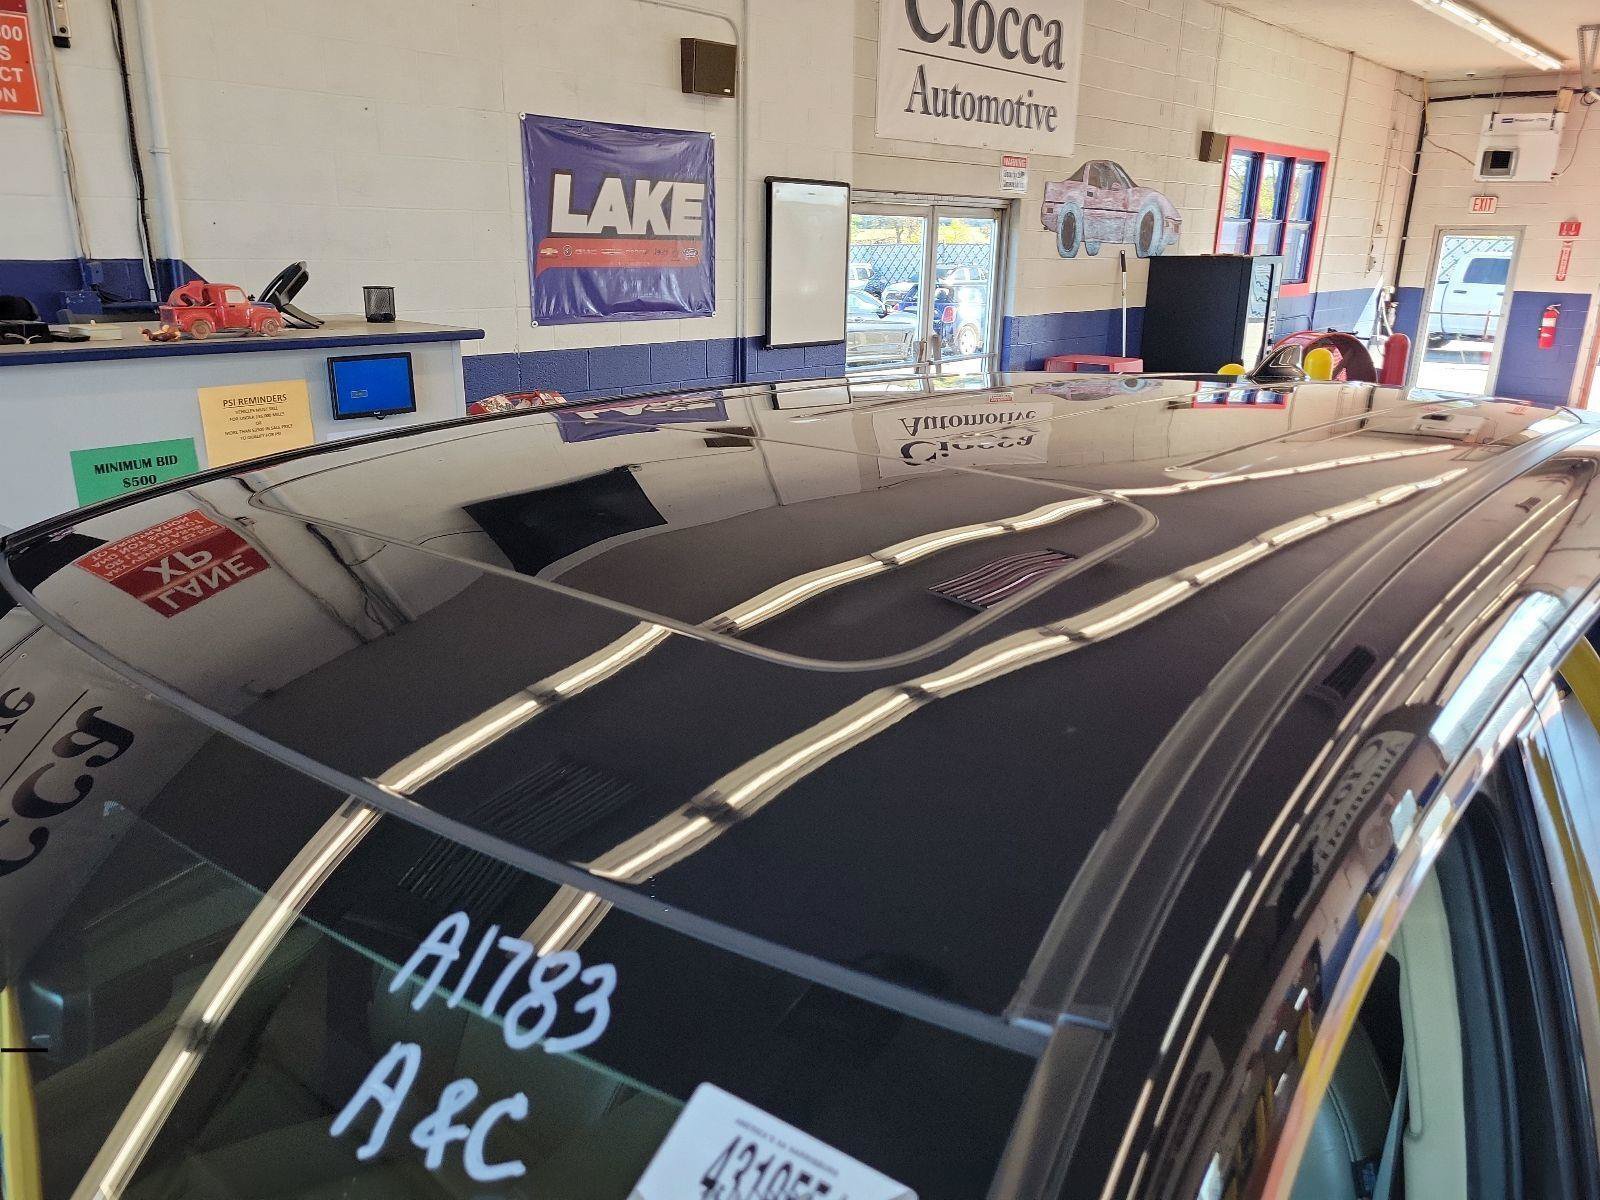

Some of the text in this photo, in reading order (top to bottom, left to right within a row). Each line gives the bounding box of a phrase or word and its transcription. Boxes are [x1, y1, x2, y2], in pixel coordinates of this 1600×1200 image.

[903, 64, 1058, 133] Automotive
[550, 172, 705, 237] LAKE
[1472, 197, 1494, 212] EXIT
[223, 394, 287, 407] PSI REMINDERS
[94, 455, 178, 475] MINIMUM BID
[122, 475, 157, 488] $500
[389, 911, 617, 1053] A1783
